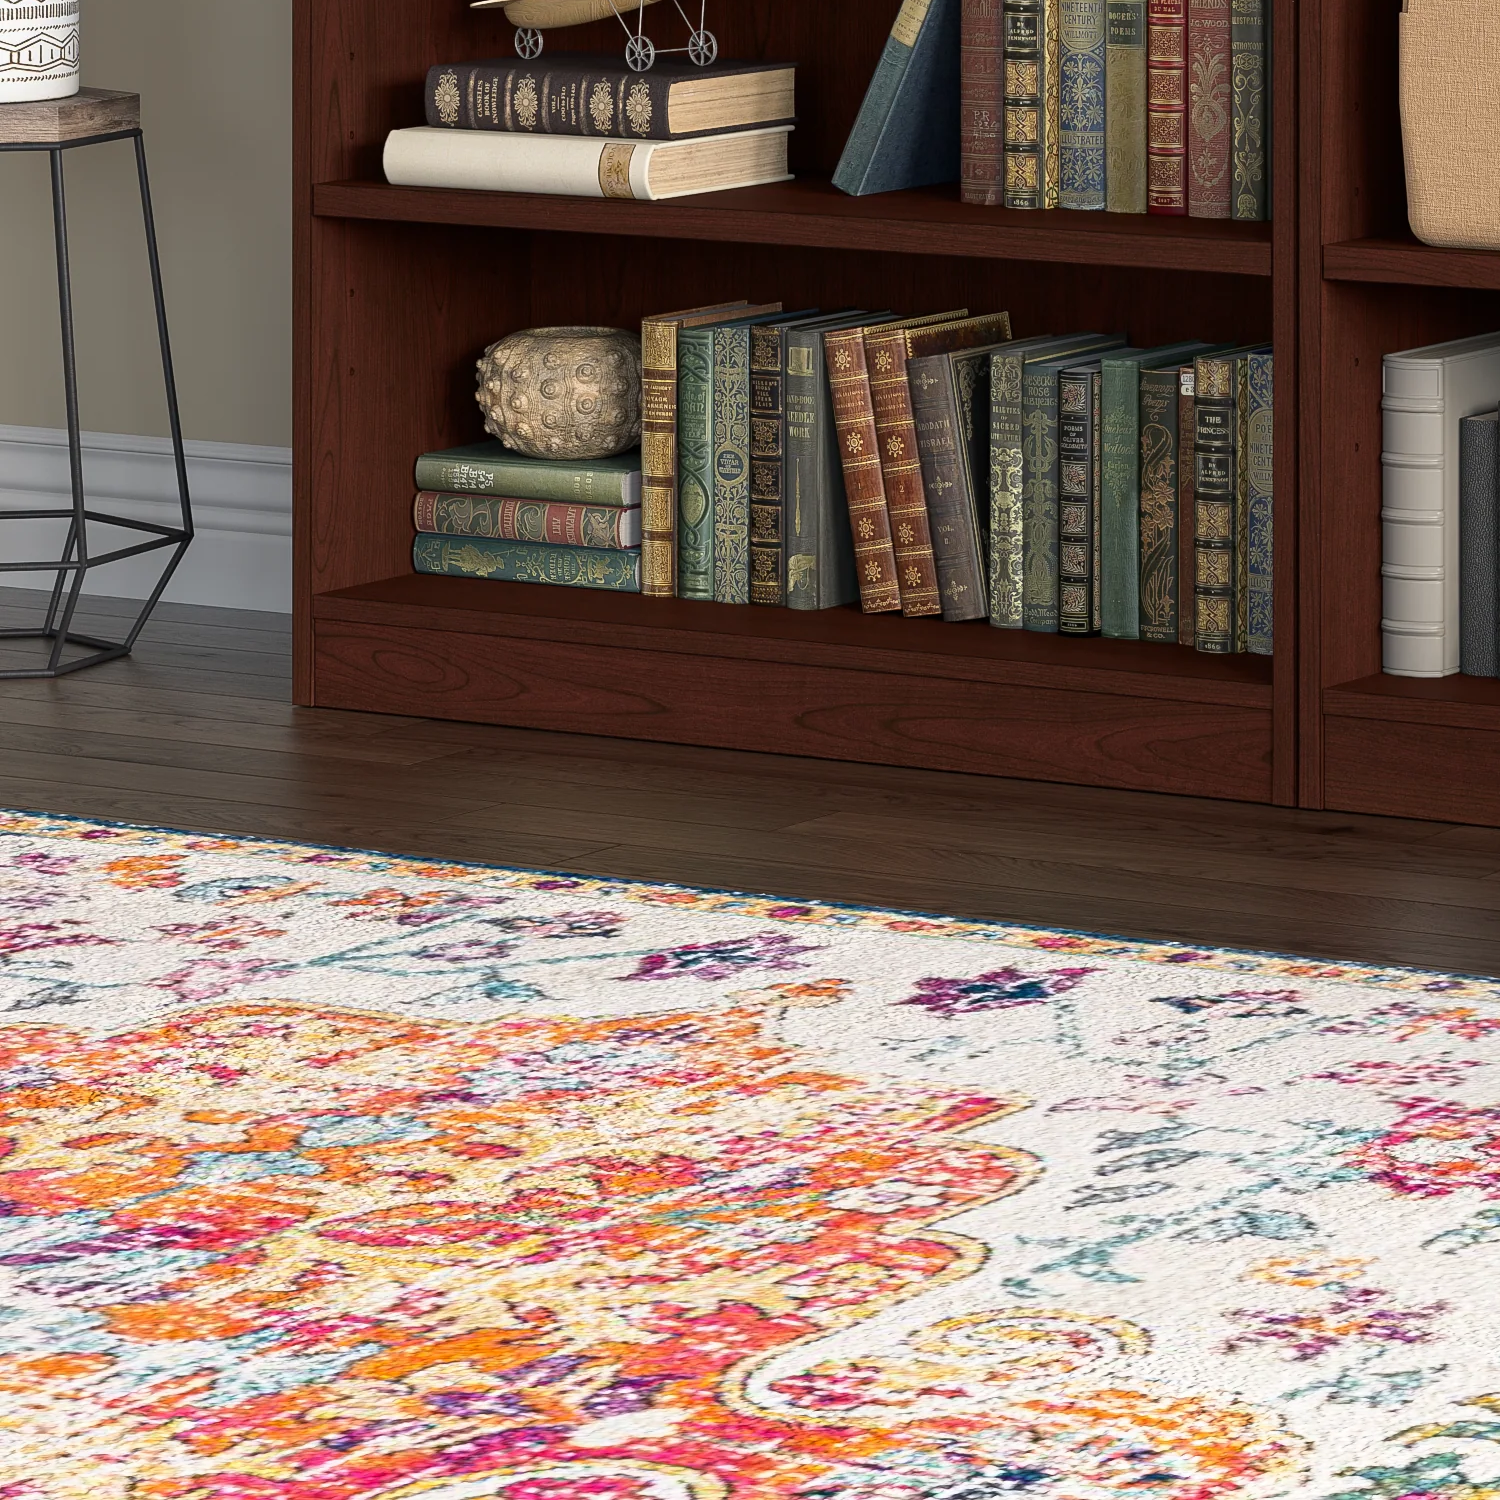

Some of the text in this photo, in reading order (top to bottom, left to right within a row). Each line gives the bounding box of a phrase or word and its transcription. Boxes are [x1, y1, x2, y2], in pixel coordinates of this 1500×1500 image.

[1062, 2, 1102, 13] NINETEENTH
[1064, 14, 1098, 25] CENTURY
[1064, 30, 1098, 39] WILLMOTT
[1110, 27, 1136, 36] POEMS
[484, 82, 490, 92] OF
[1060, 136, 1104, 145] ILLUSTRATED
[992, 406, 1020, 414] BEAUTIES
[787, 411, 815, 423] NEEDLE
[1205, 416, 1221, 424] THE
[1263, 415, 1272, 423] TH
[789, 426, 810, 438] WORK
[992, 422, 1020, 431] SACRED
[1256, 424, 1272, 434] POE
[920, 437, 951, 448] YISRAEL
[1250, 442, 1273, 454] NINETE
[1254, 455, 1273, 466] CENT
[460, 465, 469, 488] B747
[485, 473, 493, 487] PS
[1253, 471, 1272, 481] WILLM
[552, 517, 561, 535] ART
[566, 506, 576, 544] JAPANESE
[1249, 578, 1273, 589] ILLUST
[1040, 608, 1058, 617] Mead
